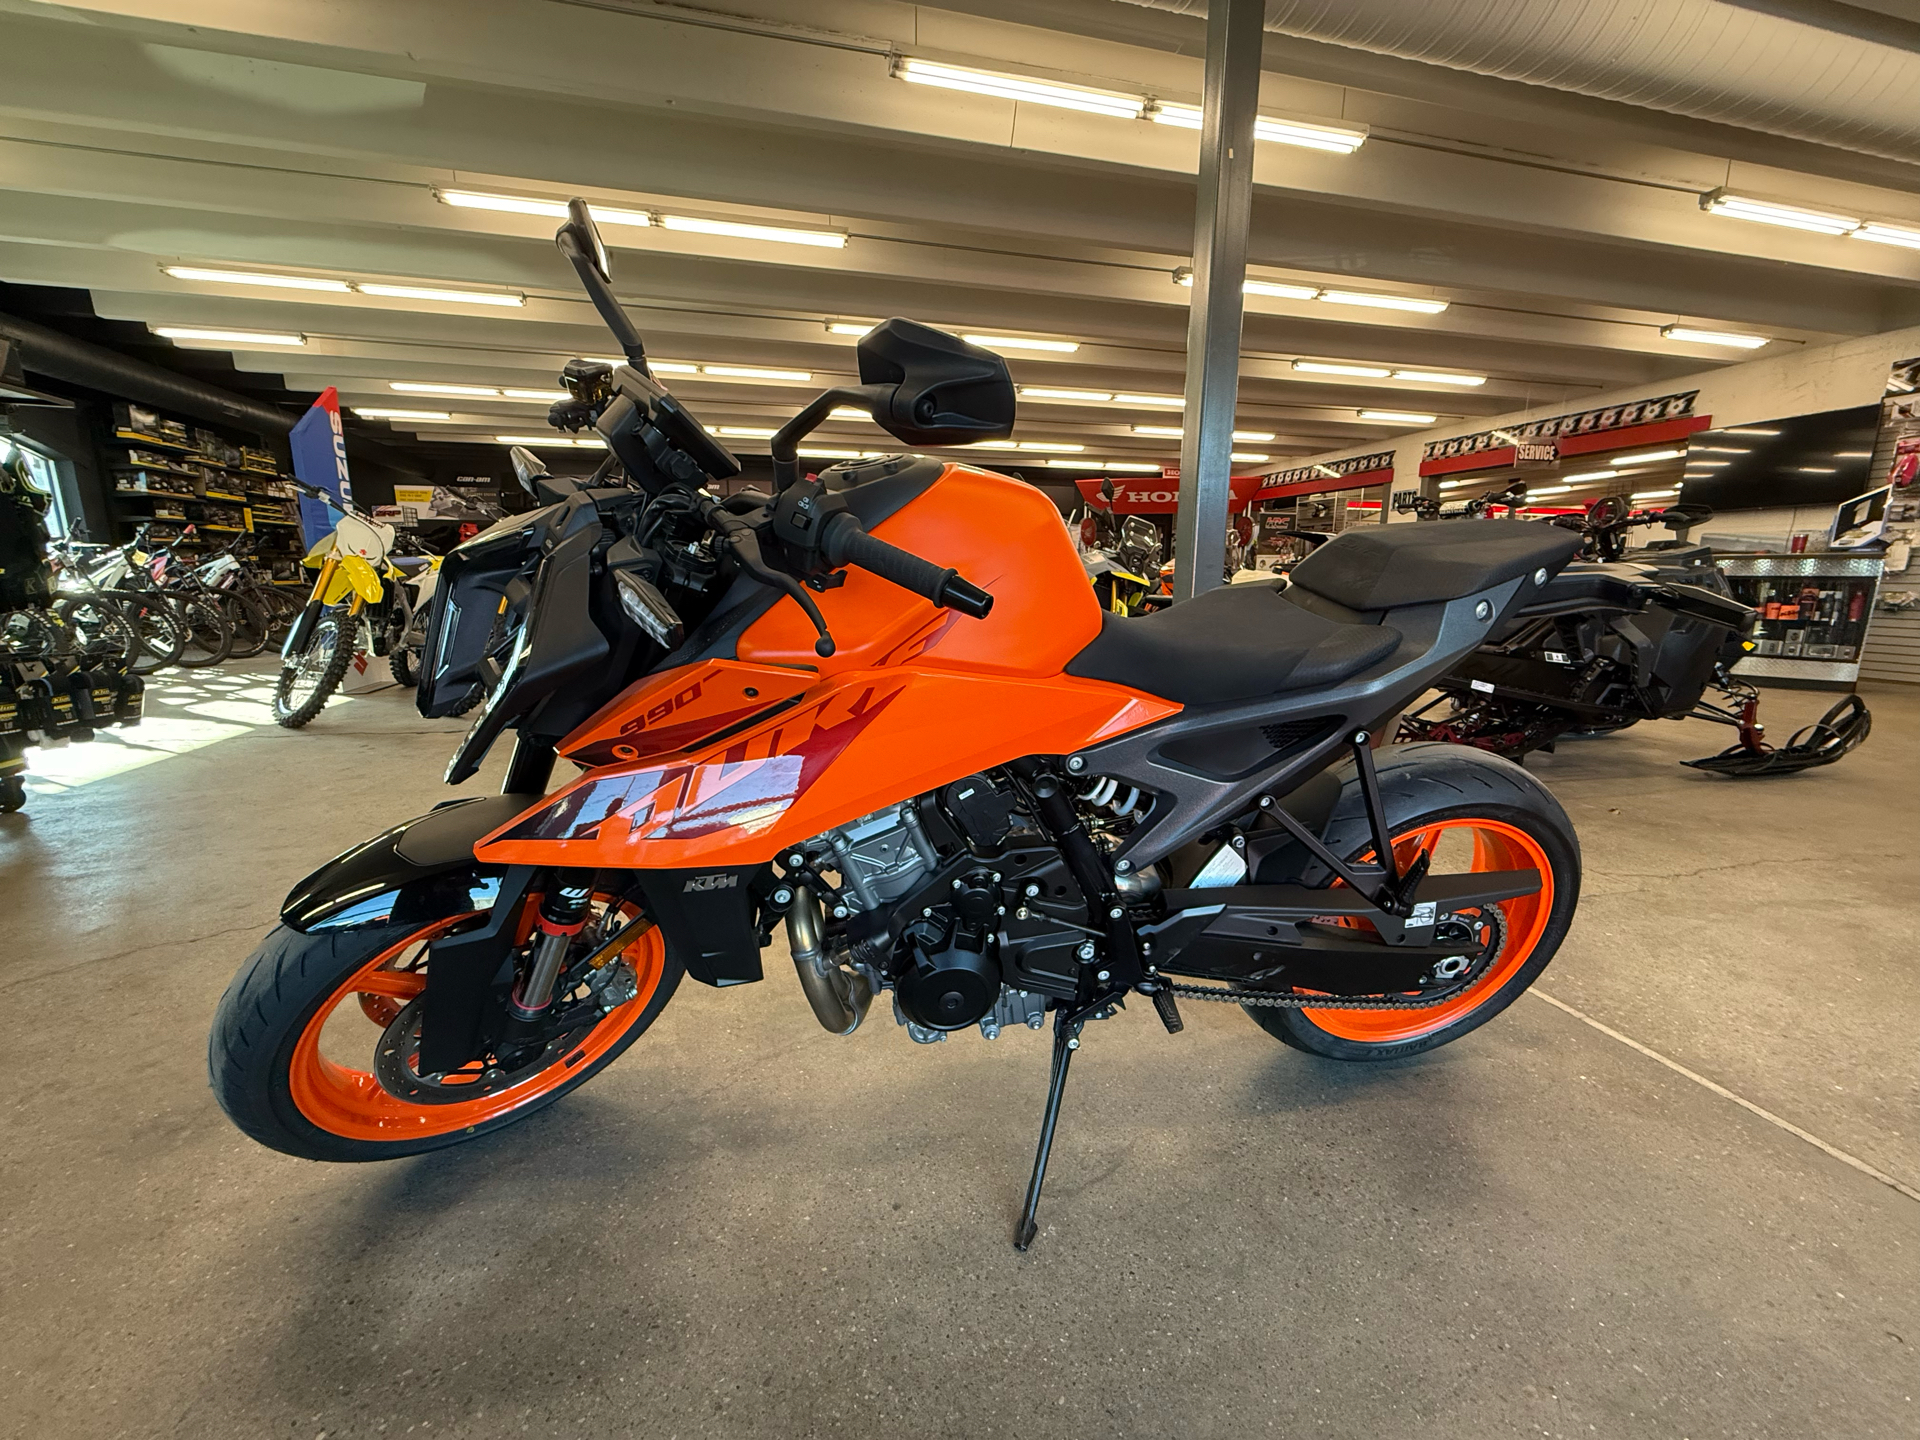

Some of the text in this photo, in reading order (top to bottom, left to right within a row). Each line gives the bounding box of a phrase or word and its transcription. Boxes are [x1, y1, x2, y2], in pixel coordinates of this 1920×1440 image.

[329, 409, 354, 514] SUZU
[1518, 444, 1556, 460] SERVICE
[619, 681, 702, 736] 990
[683, 873, 738, 892] KTM
